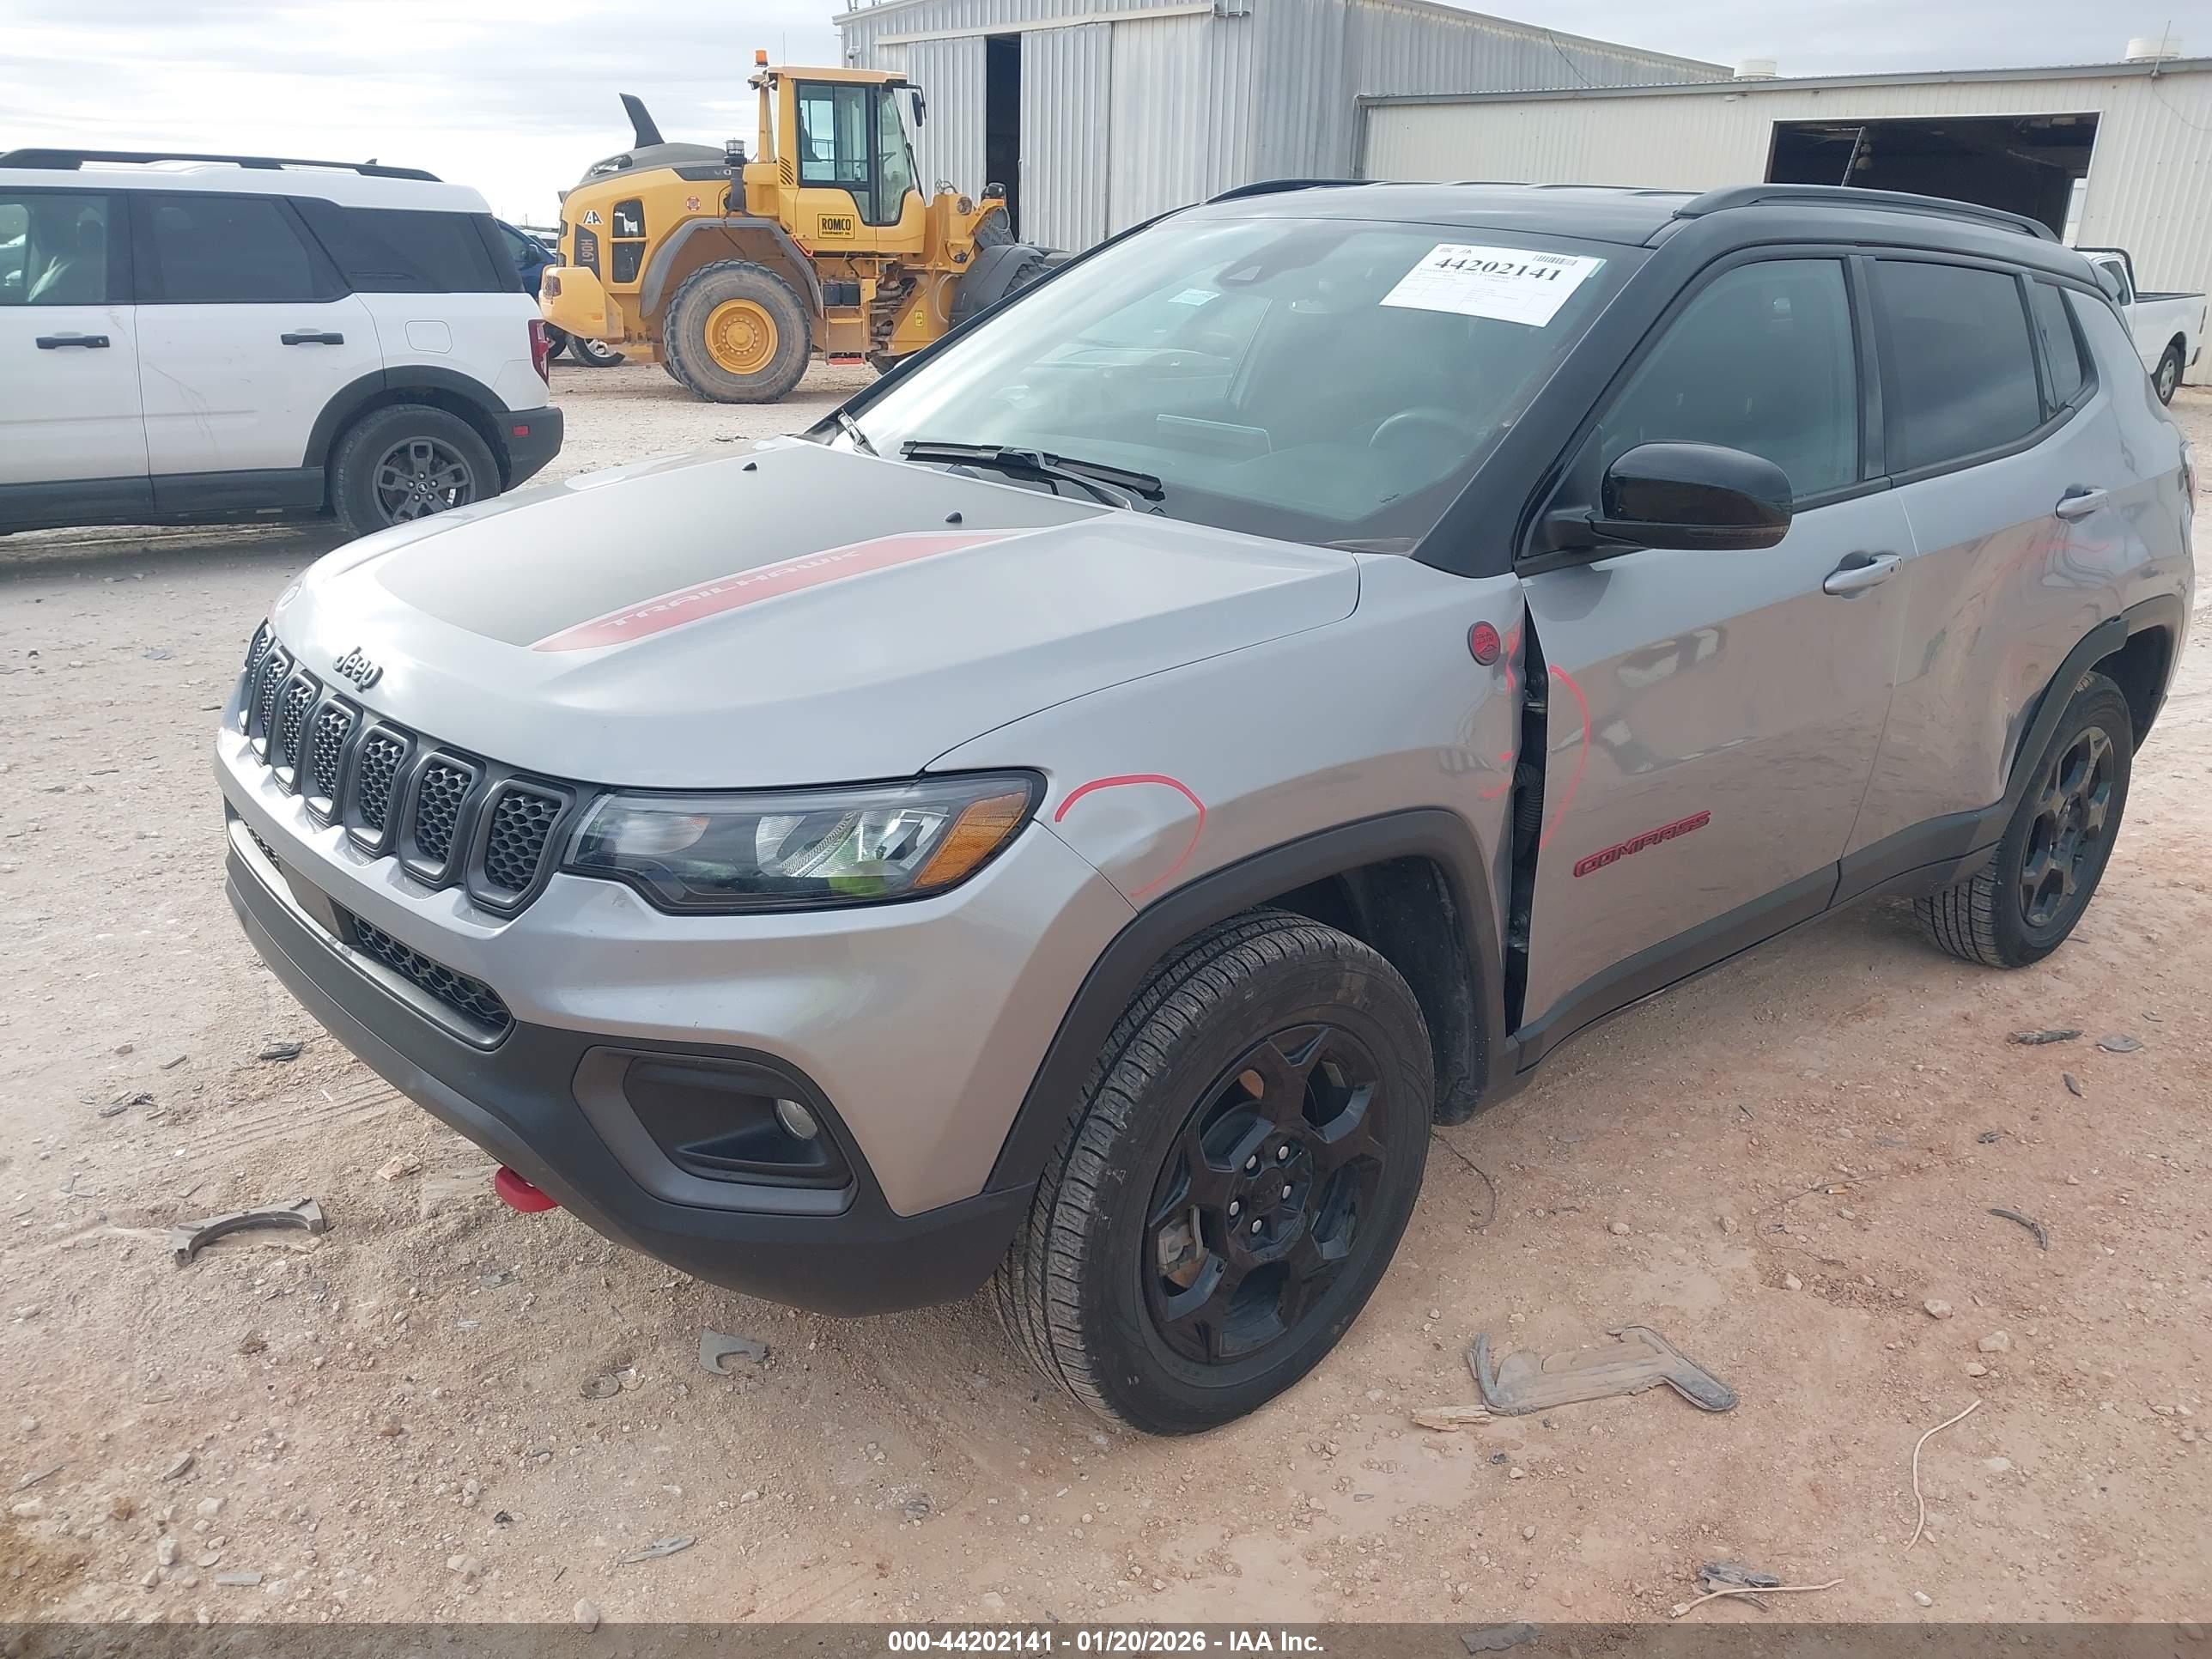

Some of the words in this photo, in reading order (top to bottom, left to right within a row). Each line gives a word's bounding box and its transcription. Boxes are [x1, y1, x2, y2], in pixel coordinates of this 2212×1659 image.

[822, 217, 851, 231] ROMCO
[580, 239, 594, 262] L90H
[1434, 258, 1562, 281] 44202141
[600, 549, 863, 627] TRAILHAWK
[332, 646, 384, 694] Jeep
[1573, 810, 1711, 878] COMPASS
